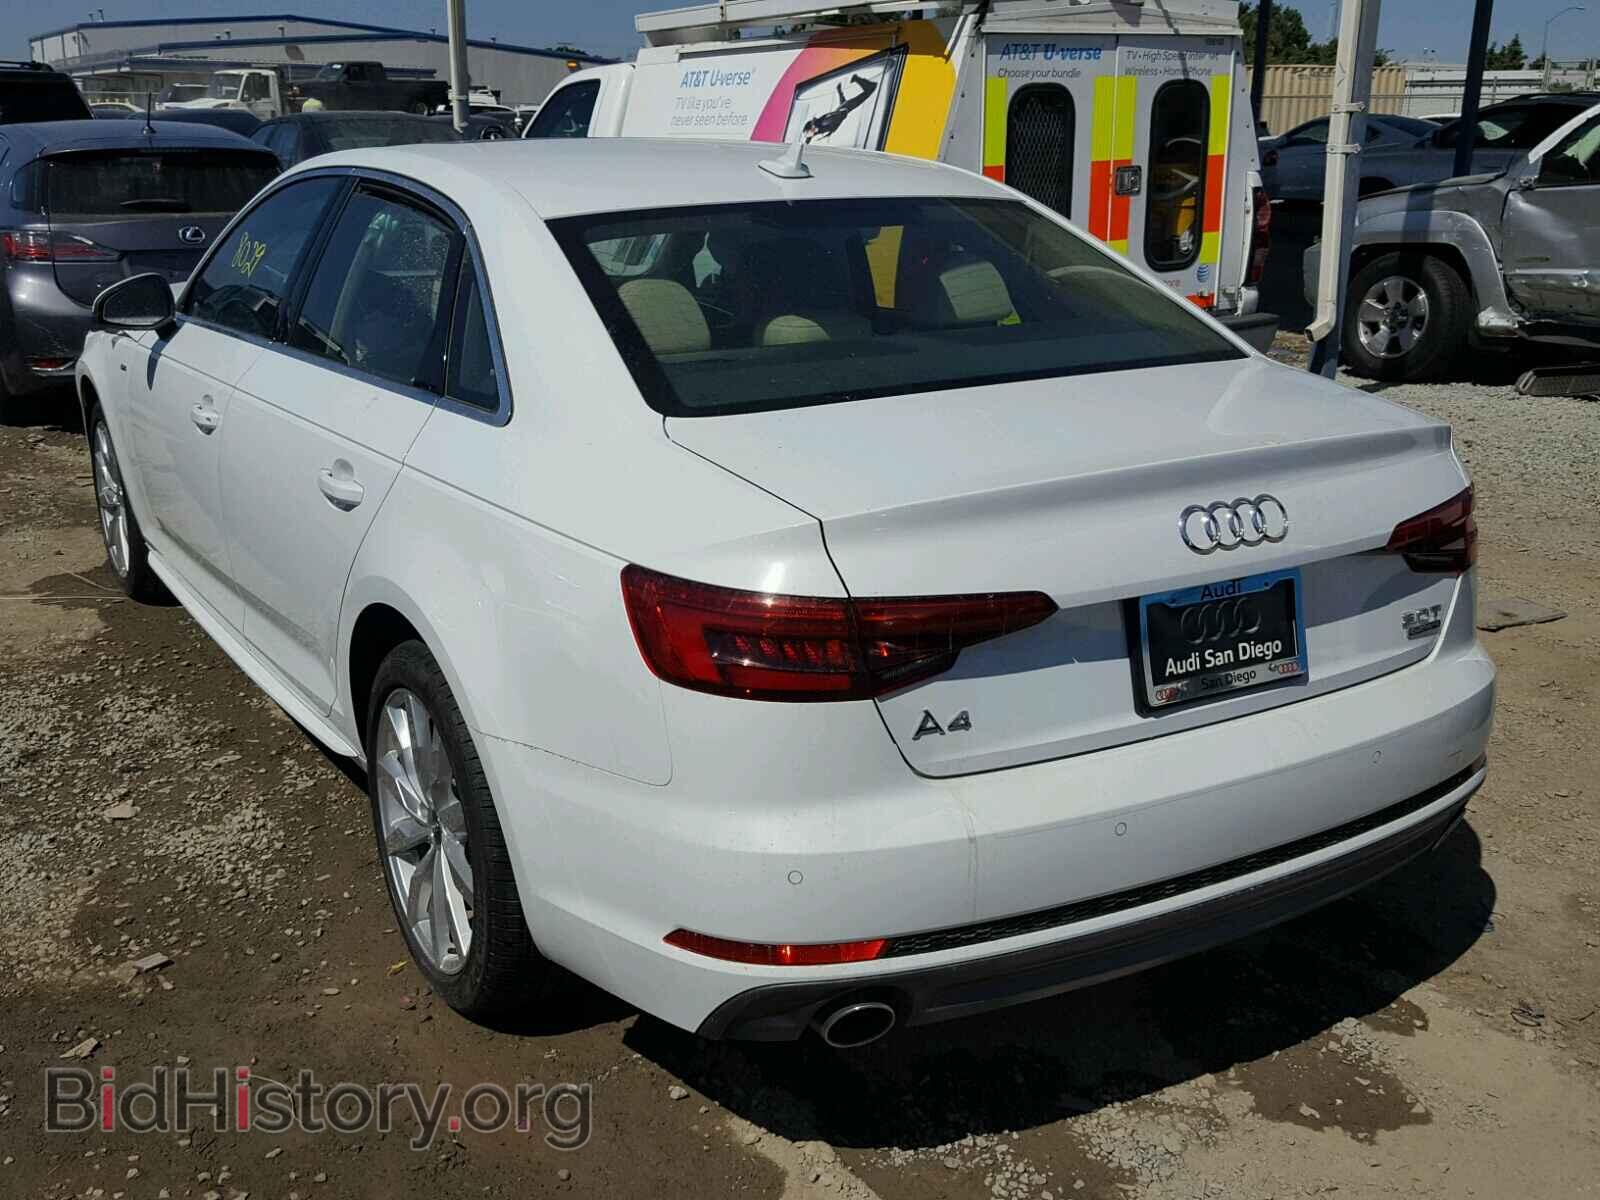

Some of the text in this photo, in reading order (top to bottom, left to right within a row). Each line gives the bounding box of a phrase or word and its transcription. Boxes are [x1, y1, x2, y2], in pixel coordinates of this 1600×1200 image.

[1000, 43, 1102, 60] AT&T U-verse
[680, 70, 709, 88] AT&T
[997, 68, 1080, 80] Choose your bundle
[1200, 579, 1242, 601] Audi
[1164, 639, 1282, 677] Audi San Diego
[1201, 669, 1257, 690] San Diego
[911, 708, 972, 741] A4
